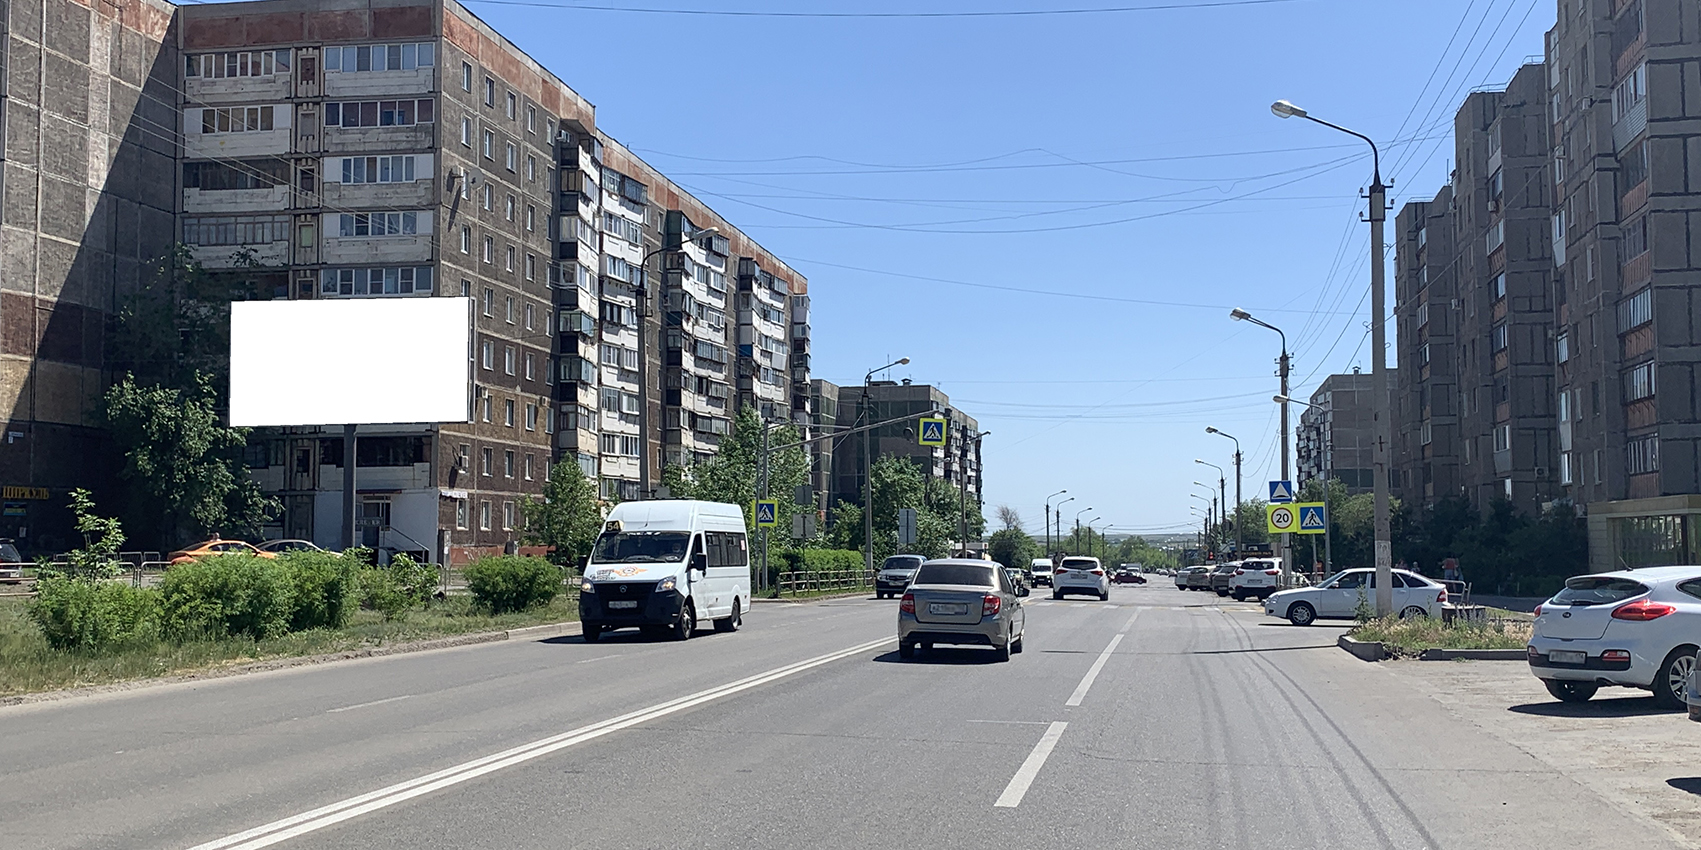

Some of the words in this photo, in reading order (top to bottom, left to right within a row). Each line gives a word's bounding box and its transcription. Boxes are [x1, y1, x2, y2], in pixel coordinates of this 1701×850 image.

[3, 486, 49, 500] ЦИРКУЛЬ
[1276, 513, 1289, 523] 20
[607, 522, 619, 531] 54
